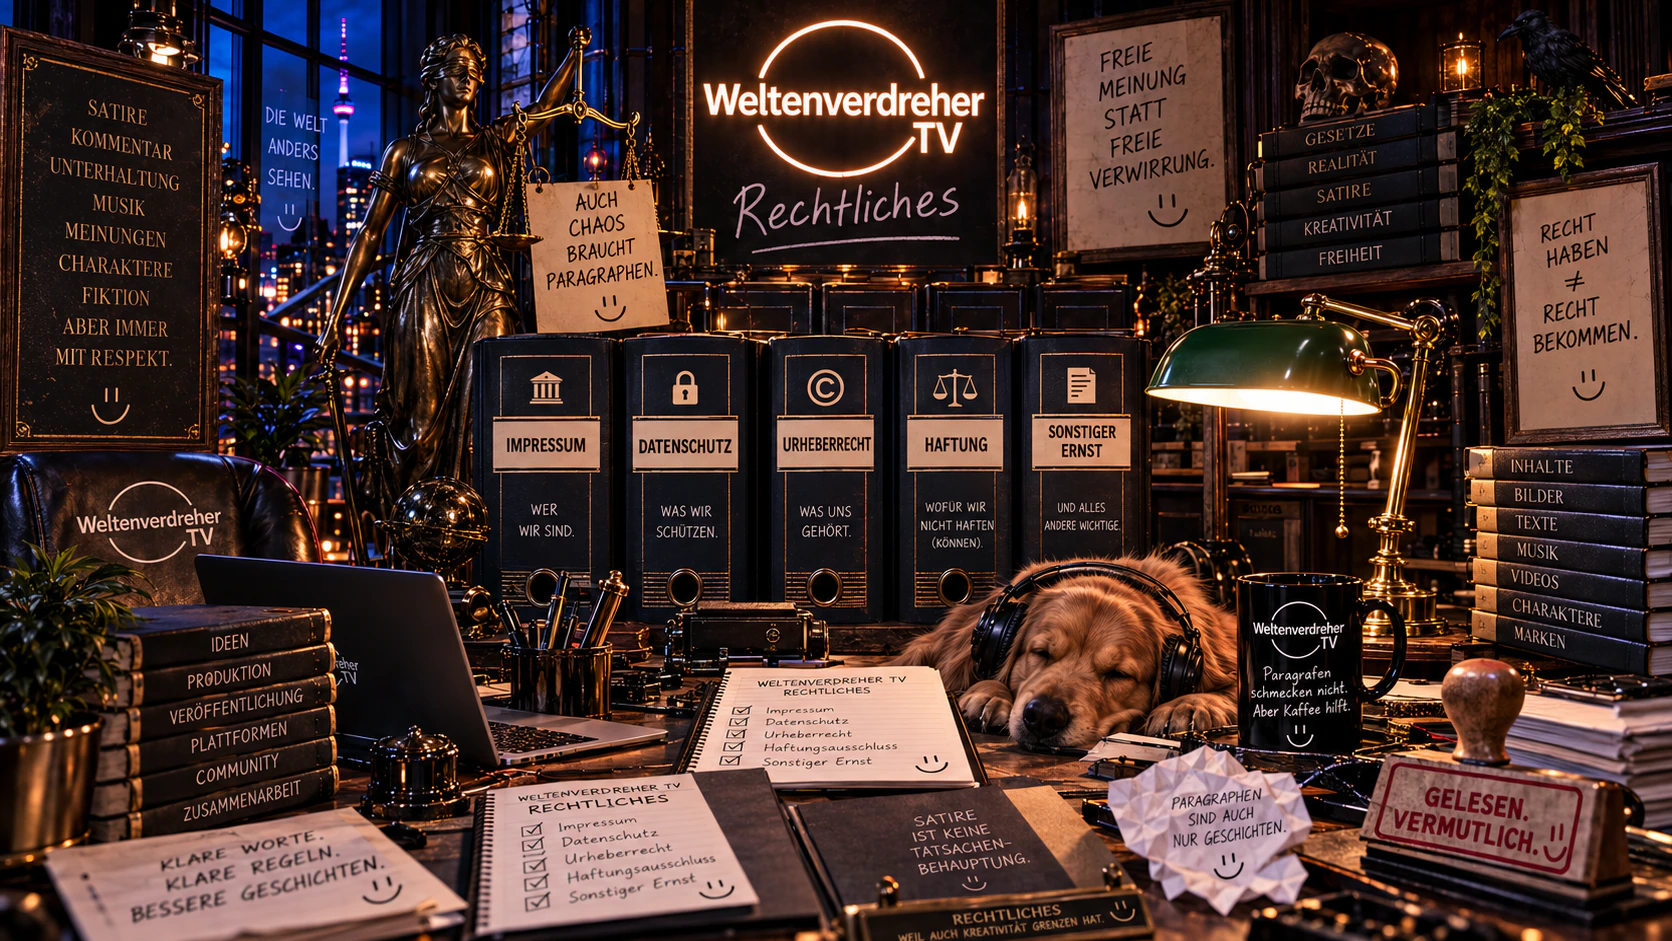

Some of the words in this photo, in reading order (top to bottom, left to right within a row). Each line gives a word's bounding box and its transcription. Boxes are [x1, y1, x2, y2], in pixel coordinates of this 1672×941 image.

[1100, 41, 1153, 69] FREIE
[1100, 65, 1186, 102] MEINUNG
[704, 83, 984, 117] Weltenverdreher
[88, 99, 148, 126] SATIRE
[265, 106, 286, 126] DIE
[293, 112, 328, 134] WELT
[1105, 98, 1166, 130] STATT
[71, 127, 172, 161] KOMMENTAR
[913, 123, 962, 153] TV
[1110, 129, 1161, 158] FREIE
[1305, 123, 1375, 146] GESETZE
[268, 138, 318, 161] ANDERS
[1090, 149, 1215, 190] VERWIRRUNG.
[1308, 150, 1377, 174] REALITÄT
[50, 157, 180, 192] UNTERHALTUNG
[268, 168, 315, 190] SEHEN.
[576, 191, 617, 211] AUCH
[1317, 182, 1371, 203] SATIRE
[93, 194, 145, 217] MUSIK
[734, 183, 959, 239] Rechtliches
[569, 215, 624, 236] CHAOS
[1304, 210, 1392, 236] KREATIVITÄT
[1541, 213, 1596, 243] RECHT
[65, 222, 166, 248] MEINUNGEN
[567, 239, 635, 262] BRAUCHT
[1319, 245, 1383, 266] FREIHEIT
[1547, 236, 1608, 268] HABEN
[59, 254, 172, 278] CHARAKTERE
[546, 261, 657, 289] PARAGRAPHEN.
[82, 286, 149, 306] FIKTION
[1543, 296, 1597, 324] RECHT
[63, 318, 109, 336] ABER
[115, 320, 168, 338] IMMER
[1534, 321, 1638, 353] BEKOMMEN.
[56, 348, 86, 366] MIT
[91, 348, 172, 367] RESPEKT.
[1049, 424, 1116, 439] SONSTIGER
[506, 437, 586, 453] IMPRESSUM
[639, 439, 732, 454] DATENSCHUTZ
[783, 436, 872, 452] URHEBERRECHT
[925, 437, 988, 453] HAFTUNG
[1061, 443, 1103, 458] ERNST
[1511, 459, 1573, 474] INHALTE
[1514, 487, 1564, 504] BILDER
[531, 504, 558, 516] WER
[661, 506, 686, 517] WAS
[690, 505, 712, 517] WIR
[799, 505, 824, 518] WAS
[828, 505, 851, 518] UNS
[925, 501, 961, 513] WOFÜR
[966, 501, 986, 513] WIR
[1057, 502, 1075, 513] UND
[1079, 502, 1106, 513] ALLES
[76, 507, 221, 534] Weltenverdreher
[519, 525, 541, 537] WIR
[544, 525, 575, 537] SIND.
[802, 524, 851, 538] GEHÖRT.
[920, 519, 952, 532] NICHT
[956, 519, 995, 532] HAFTEN
[1044, 520, 1076, 531] ANDERE
[1079, 519, 1121, 531] WICHTIGE.
[1515, 514, 1558, 531] TEXTE
[186, 528, 214, 547] TV
[656, 524, 718, 539] SCHÜTZEN.
[932, 536, 983, 549] (KÖNNEN).
[1517, 542, 1559, 560] MUSIK
[1511, 569, 1559, 589] VIDEOS
[1512, 598, 1602, 628] CHARAKTERE
[1253, 621, 1345, 635] Weltenverdreher
[1514, 625, 1565, 649] MARKEN
[211, 633, 249, 653] IDEEN
[1320, 635, 1338, 649] TV
[187, 662, 271, 690] PRODUKTION
[341, 671, 357, 685] TV
[758, 677, 883, 688] WELTENVERDREHER
[1263, 665, 1331, 685] Paragrafen
[783, 687, 871, 697] RECHTLICHES
[1251, 683, 1312, 698] schmecken
[1317, 681, 1348, 696] nicht.
[169, 687, 304, 725] VERÖFFENTLICHUNG
[766, 707, 834, 716] Impressum
[1253, 704, 1279, 717] Aber
[1284, 702, 1321, 717] Kaffee
[1326, 698, 1351, 713] hilft.
[766, 717, 849, 726] Datenschutz
[191, 720, 287, 755] PLATTFORMEN
[764, 730, 852, 739] Urheberrecht
[764, 742, 898, 755] Haftungsausschluss
[196, 753, 279, 786] COMMUNITY
[762, 757, 828, 769] Sonstiger
[836, 757, 872, 766] Ernst
[183, 780, 301, 823] ZUSAMMENARBEIT
[518, 784, 659, 802] WELTENVERDREHER
[664, 782, 681, 790] TV
[1171, 787, 1263, 810] PARAGRAPHEN
[529, 794, 669, 815] RECHTLICHES
[1424, 786, 1529, 822] GELESEN.
[558, 817, 637, 833] Impressum
[914, 808, 977, 827] SATIRE
[1188, 810, 1217, 827] SIND
[1222, 806, 1254, 823] AUCH
[562, 829, 659, 848] Datenschutz
[912, 828, 938, 843] IST
[943, 823, 991, 840] KEINE
[1173, 832, 1199, 848] NUR
[1204, 819, 1287, 846] GESCHICHTEN.
[1393, 808, 1538, 856] VERMUTLICH.
[160, 848, 227, 872] KLARE
[241, 829, 325, 855] WORTE.
[565, 843, 673, 865] Urheberrecht
[910, 839, 1012, 859] TATSACHEN-
[165, 866, 235, 892] KLARE
[251, 846, 340, 876] REGELN.
[567, 855, 716, 884] Haftungsausschluss
[918, 852, 1031, 876] BEHAUPTUNG.
[131, 891, 228, 923] BESSERE
[241, 856, 385, 902] GESCHICHTEN.
[569, 882, 644, 904] Sonstiger
[653, 873, 697, 890] Ernst
[952, 904, 1062, 926] RECHTLICHES
[898, 932, 925, 941] WEIL
[929, 929, 958, 941] AUCH
[963, 921, 1028, 938] KREATIVITÄT
[1032, 918, 1078, 931] GRENZEN
[1082, 914, 1105, 925] HAT.
